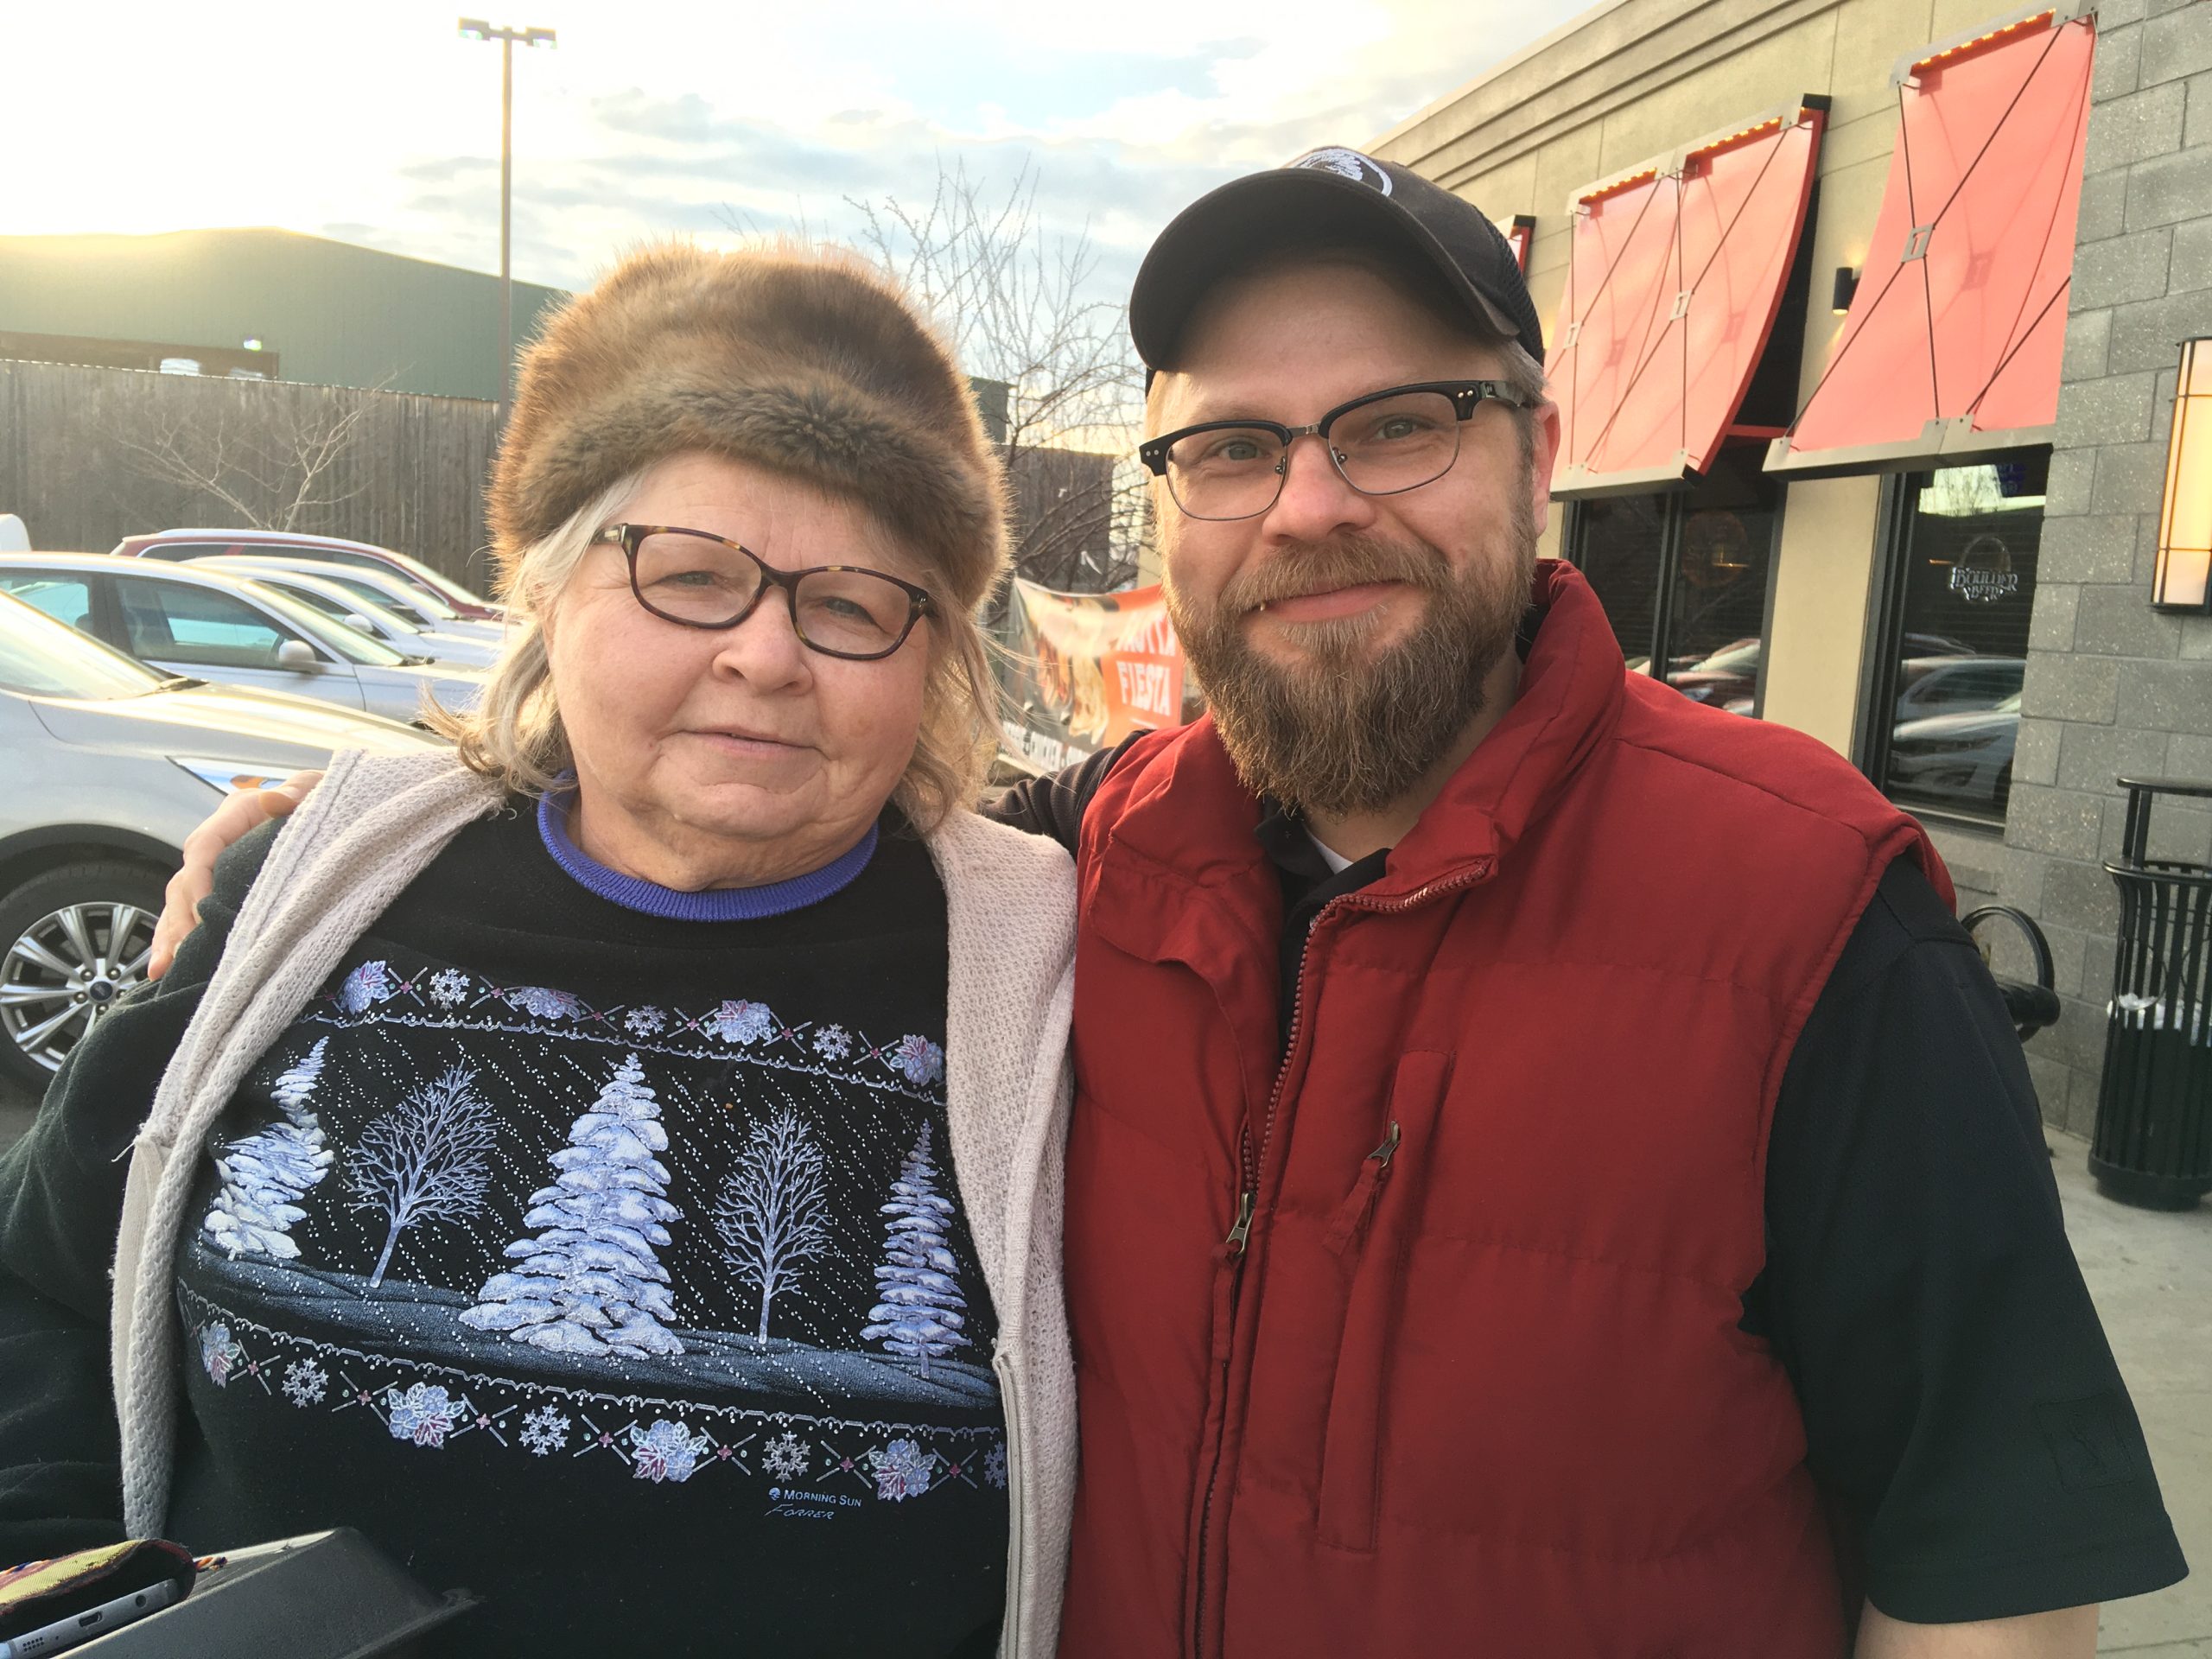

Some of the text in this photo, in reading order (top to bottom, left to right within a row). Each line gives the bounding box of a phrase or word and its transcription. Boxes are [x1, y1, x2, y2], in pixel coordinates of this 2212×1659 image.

[1116, 661, 1170, 716] FIESTA
[784, 1490, 861, 1507] MORNING SUN
